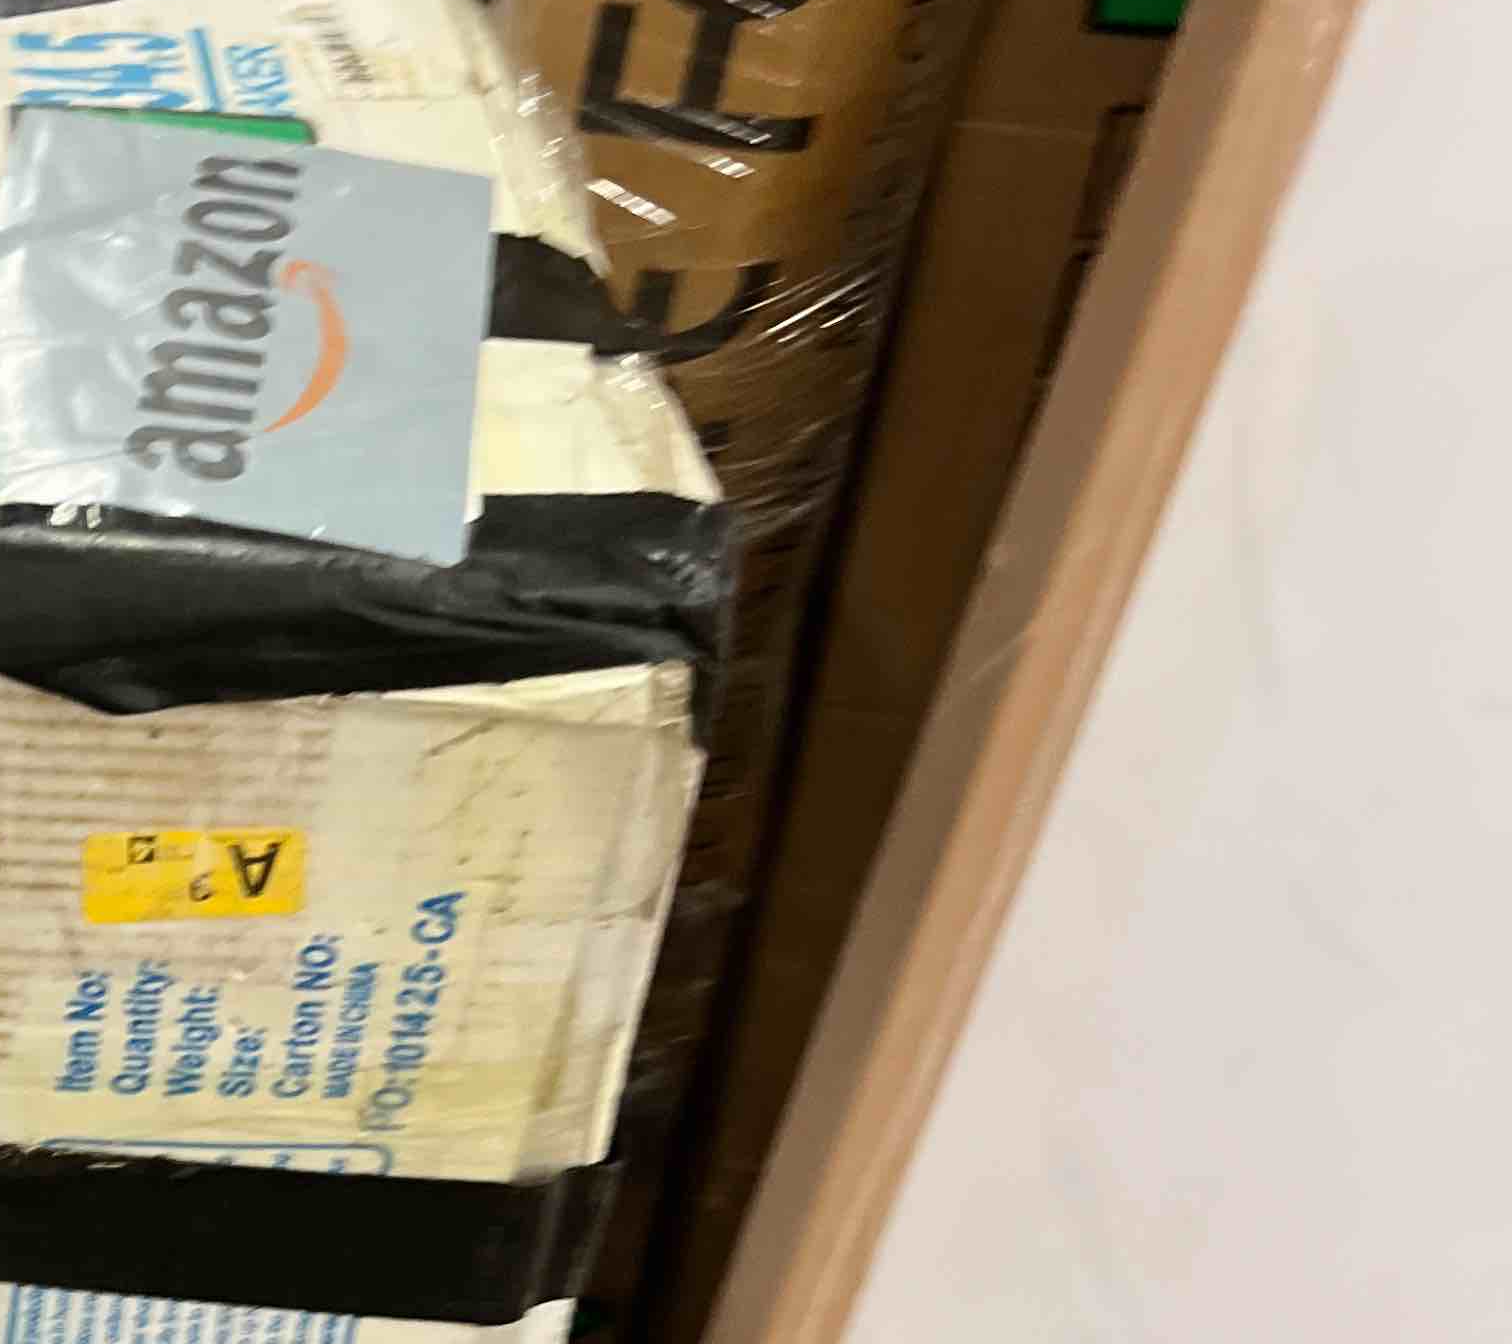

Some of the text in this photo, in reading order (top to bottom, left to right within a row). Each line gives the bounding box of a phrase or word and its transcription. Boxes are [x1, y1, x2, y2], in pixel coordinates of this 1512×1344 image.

[123, 154, 306, 483] amazon
[228, 840, 288, 897] A
[55, 1030, 104, 1095] Item
[109, 959, 180, 1096] Quantity:
[163, 982, 224, 1098] Weight:
[216, 1026, 267, 1099] Size:
[270, 1000, 330, 1100] Carton
